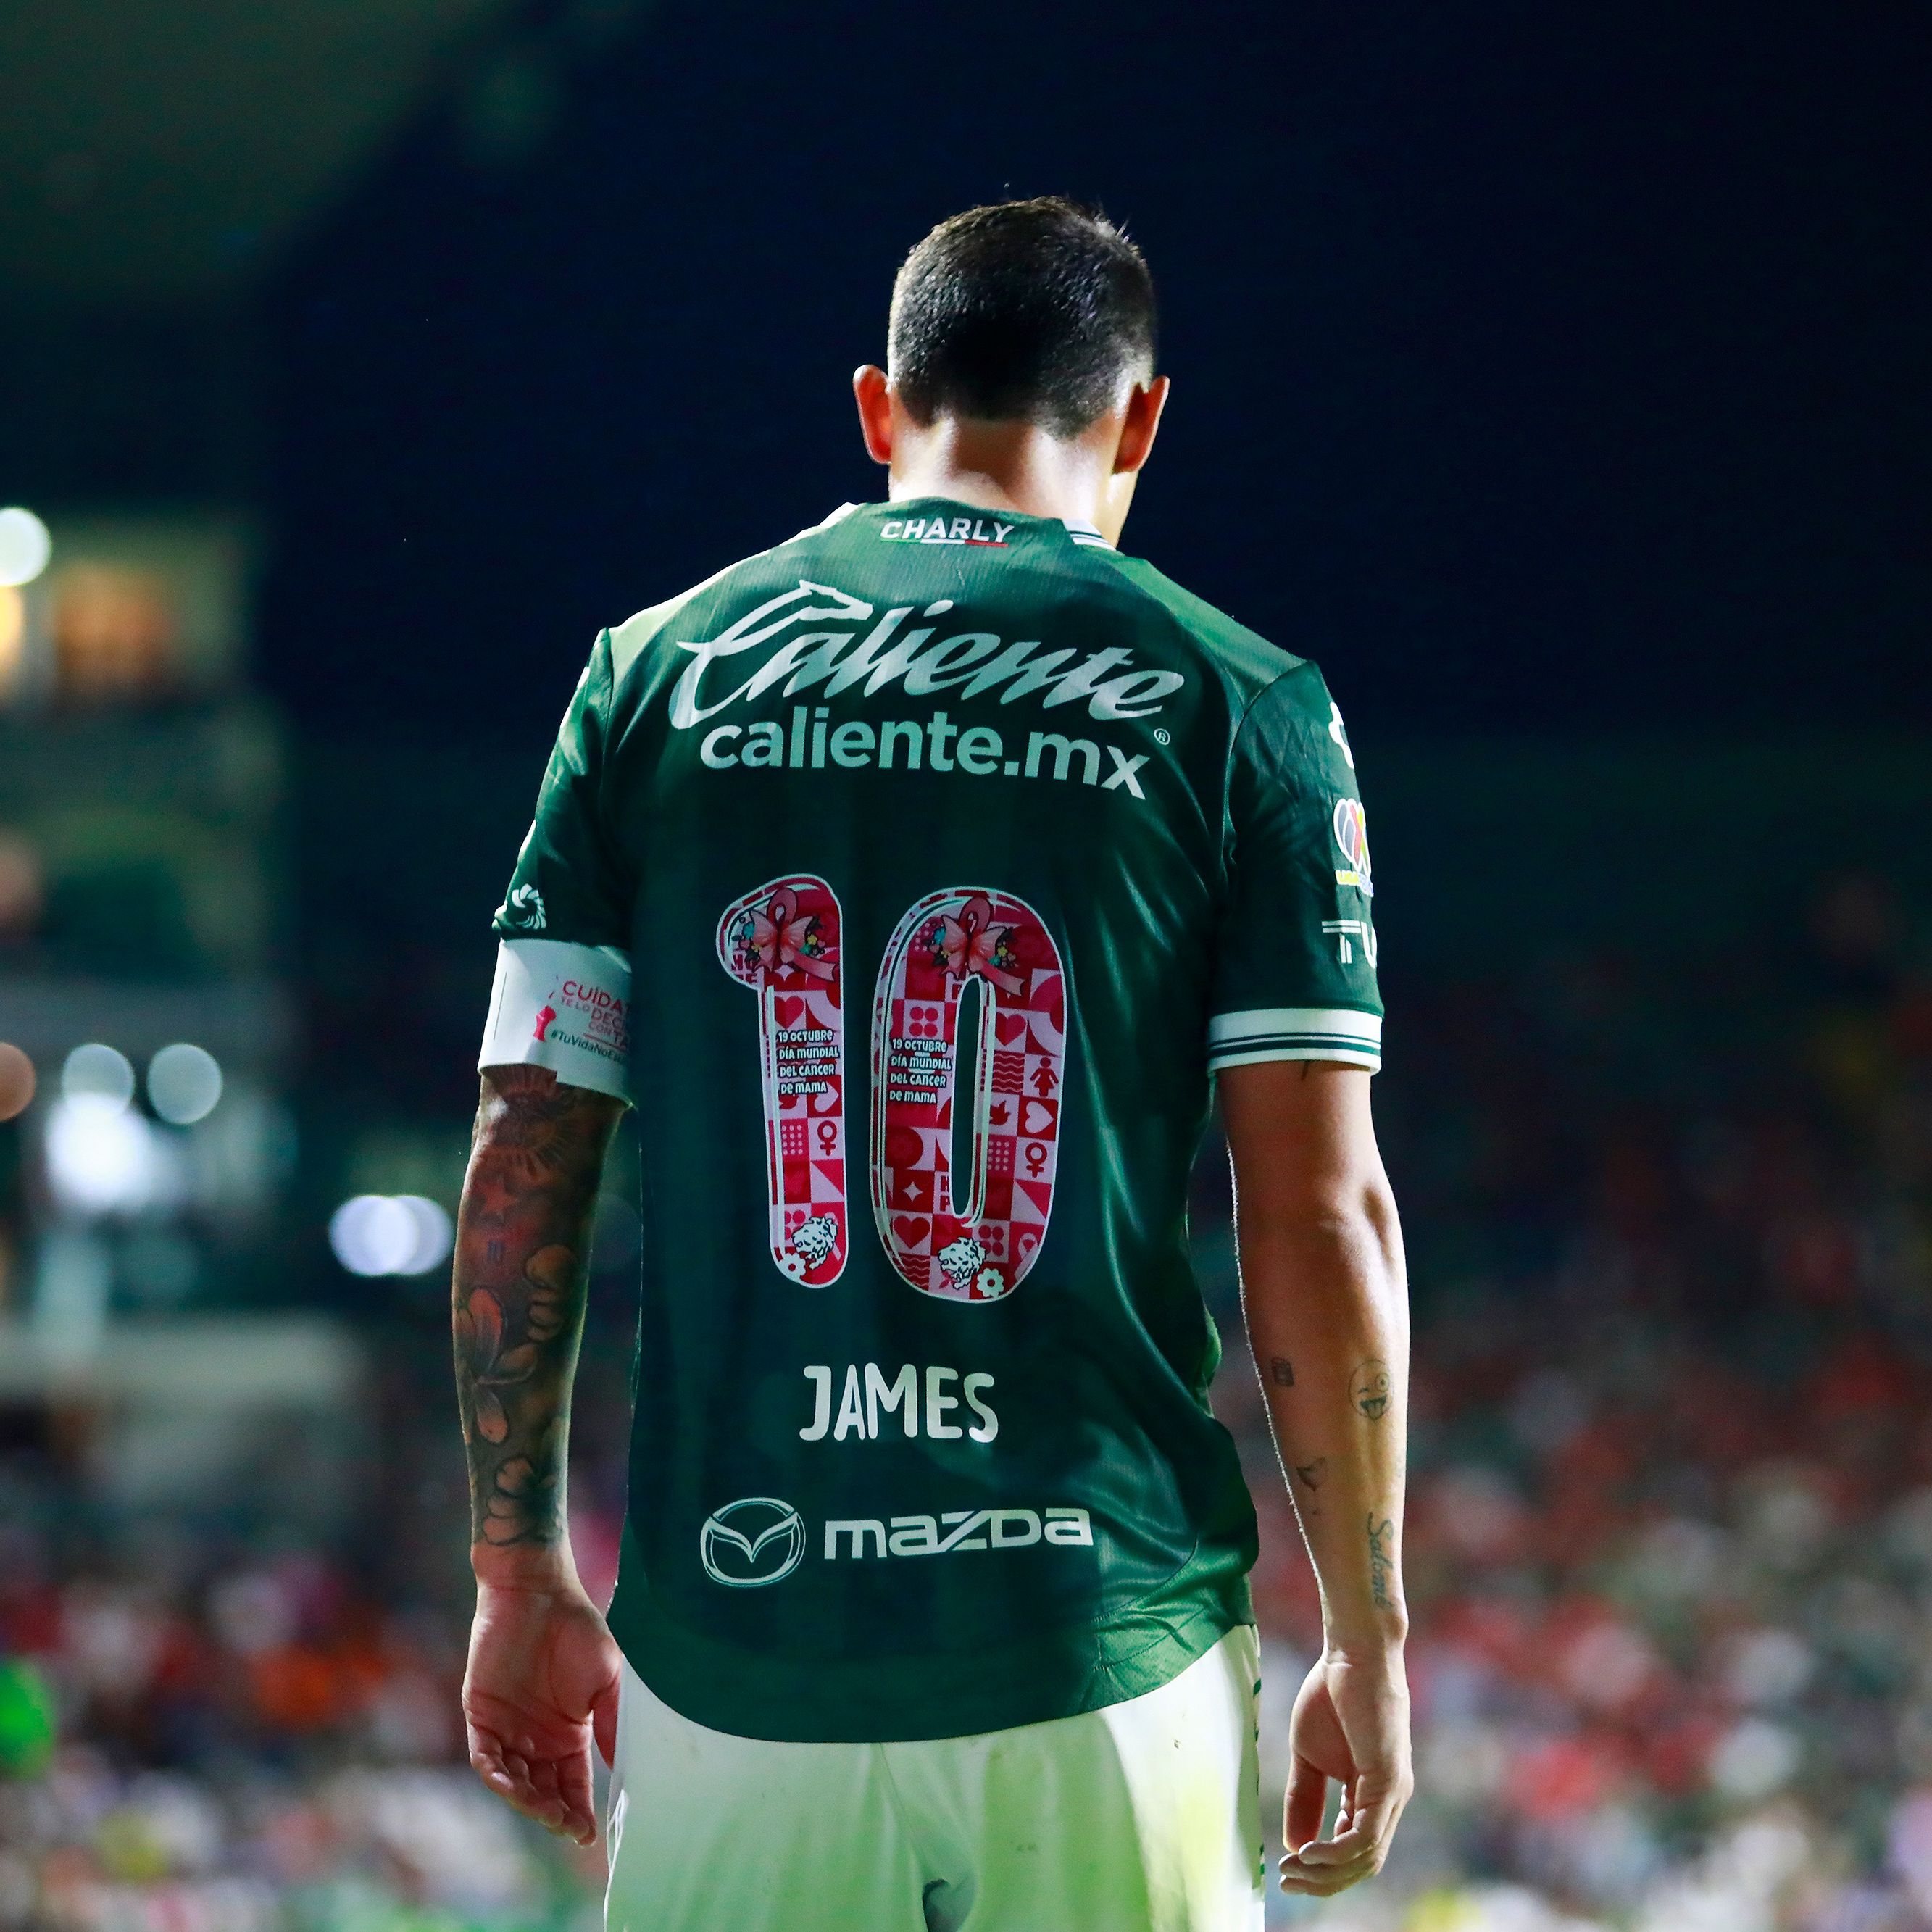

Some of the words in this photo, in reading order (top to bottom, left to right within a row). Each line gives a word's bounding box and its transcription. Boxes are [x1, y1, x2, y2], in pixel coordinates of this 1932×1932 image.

[880, 517, 1014, 543] CHARLY
[668, 579, 1184, 730] Caliente
[699, 705, 1152, 800] caliente.mx
[778, 1030, 788, 1043] 19
[790, 1029, 833, 1041] OCTUBRE
[779, 1046, 795, 1059] DÍA
[797, 1046, 839, 1059] MUNDIAL
[892, 1038, 903, 1050] 19
[904, 1039, 947, 1052] OCTUBRE
[891, 1053, 907, 1067] DÍA
[909, 1057, 952, 1070] MUNDIAL
[780, 1065, 797, 1078] DEL
[799, 1063, 835, 1076] CANCER
[780, 1083, 794, 1094] DE
[795, 1081, 827, 1094] MAMA
[890, 1073, 908, 1084] DEL
[909, 1074, 946, 1087] CANCER
[716, 873, 1067, 1303] 10
[889, 1090, 902, 1102] DE
[904, 1091, 936, 1104] MAMA
[799, 1362, 999, 1443] JAMES
